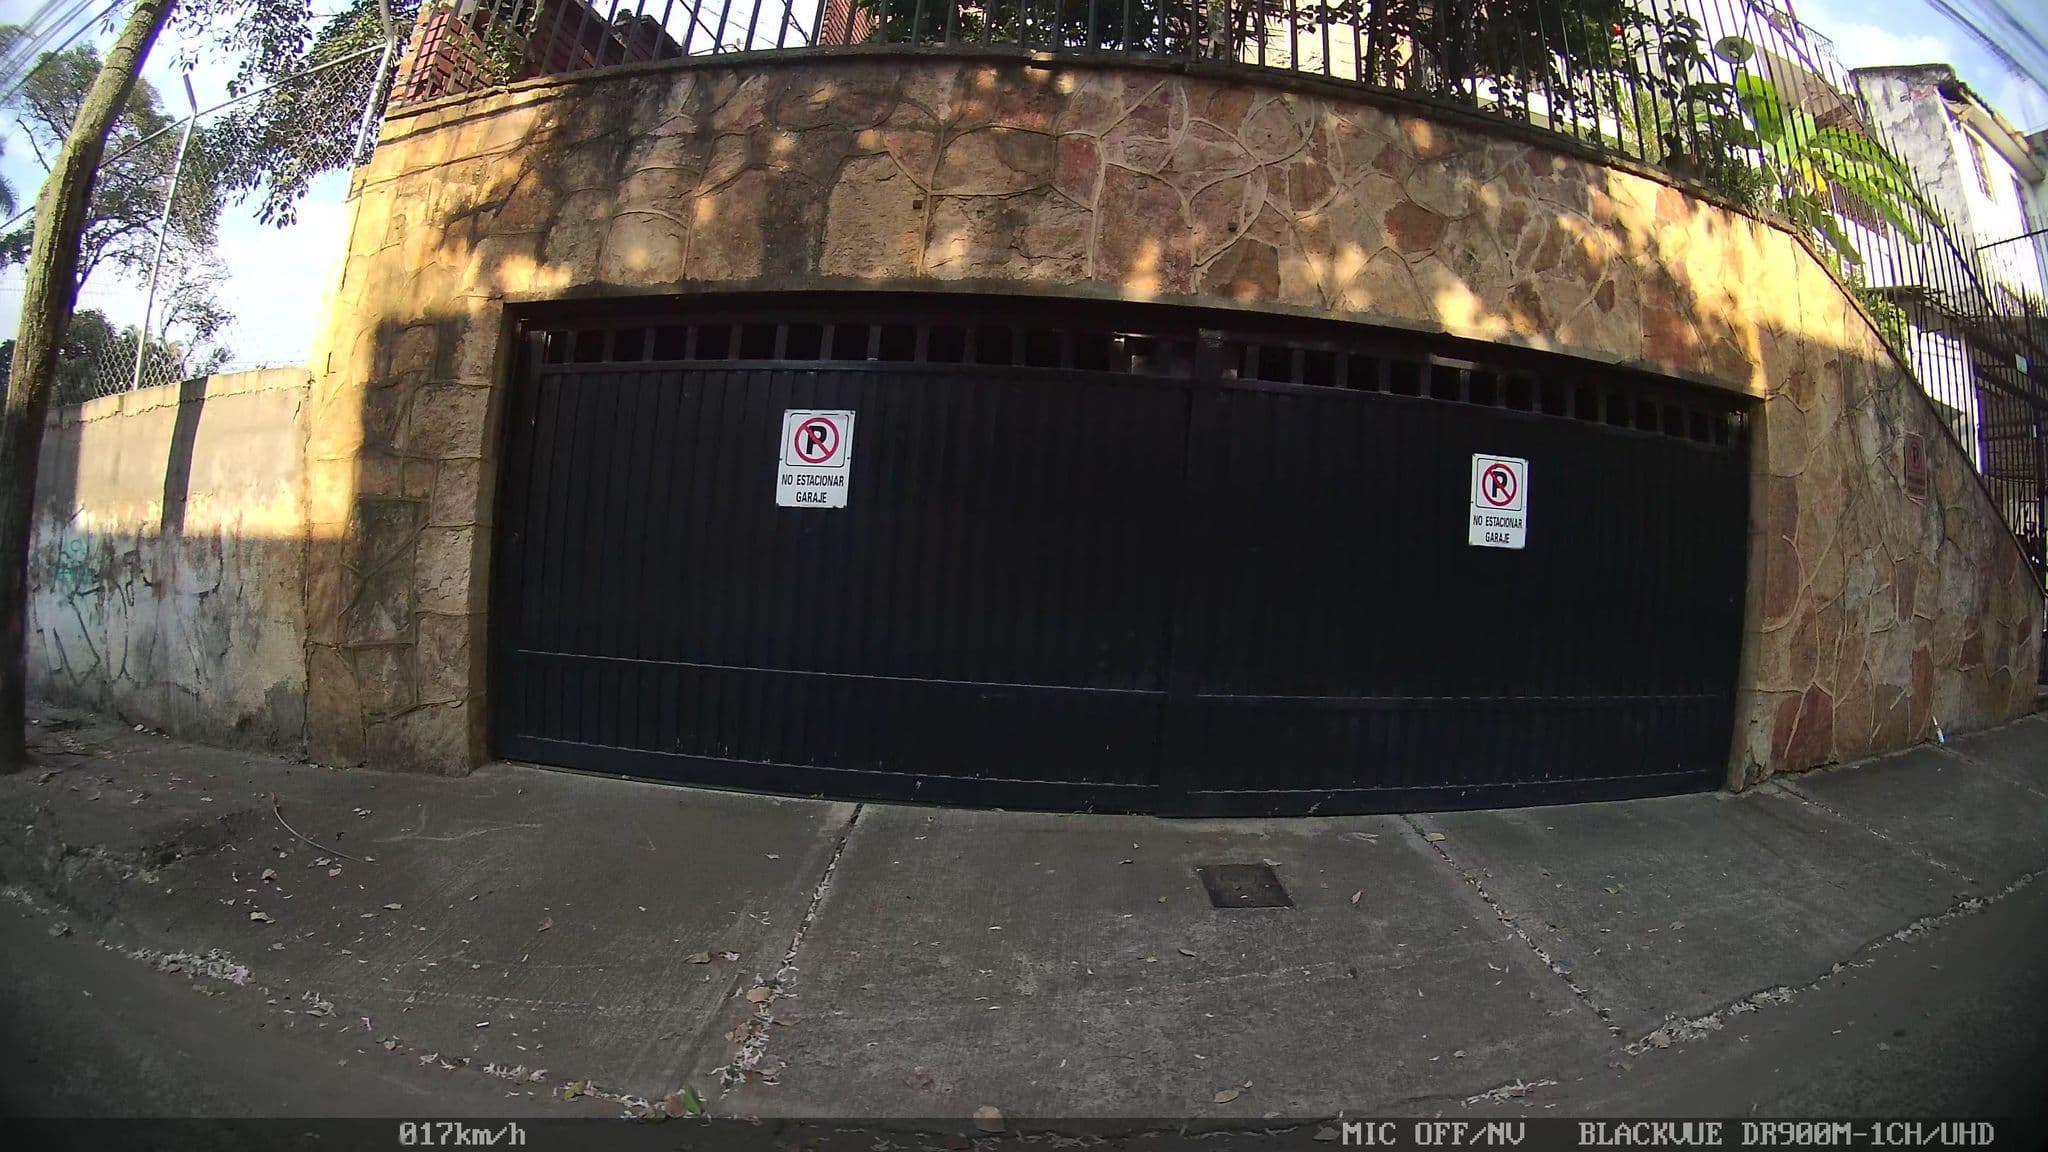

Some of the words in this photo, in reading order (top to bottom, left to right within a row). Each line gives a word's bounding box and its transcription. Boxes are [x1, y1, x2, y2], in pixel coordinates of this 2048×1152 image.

[806, 425, 827, 455] P
[781, 474, 793, 486] NO
[796, 474, 845, 487] ESTACIONAR
[1491, 470, 1508, 498] P
[796, 491, 827, 504] GARAJE
[1473, 515, 1483, 526] NO
[1485, 515, 1523, 529] ESTACIONAR
[1485, 531, 1510, 544] GARAJE
